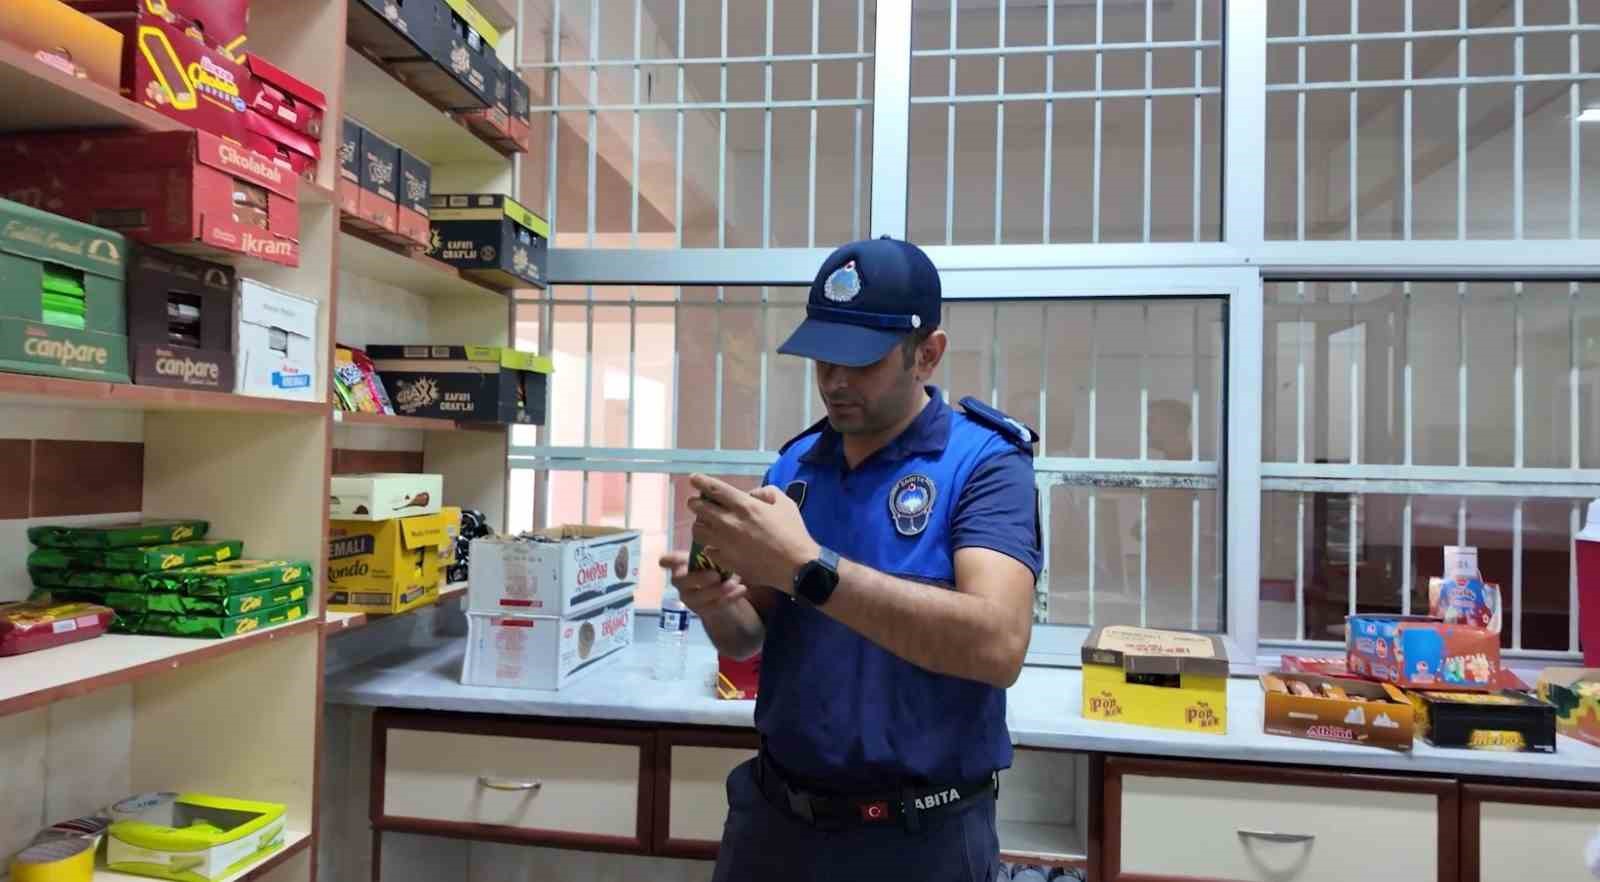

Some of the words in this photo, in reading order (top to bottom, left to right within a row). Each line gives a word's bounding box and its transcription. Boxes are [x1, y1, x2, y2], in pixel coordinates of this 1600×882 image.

[241, 233, 291, 255] ikram
[328, 538, 366, 555] EMALI
[902, 788, 961, 813] ABITA
